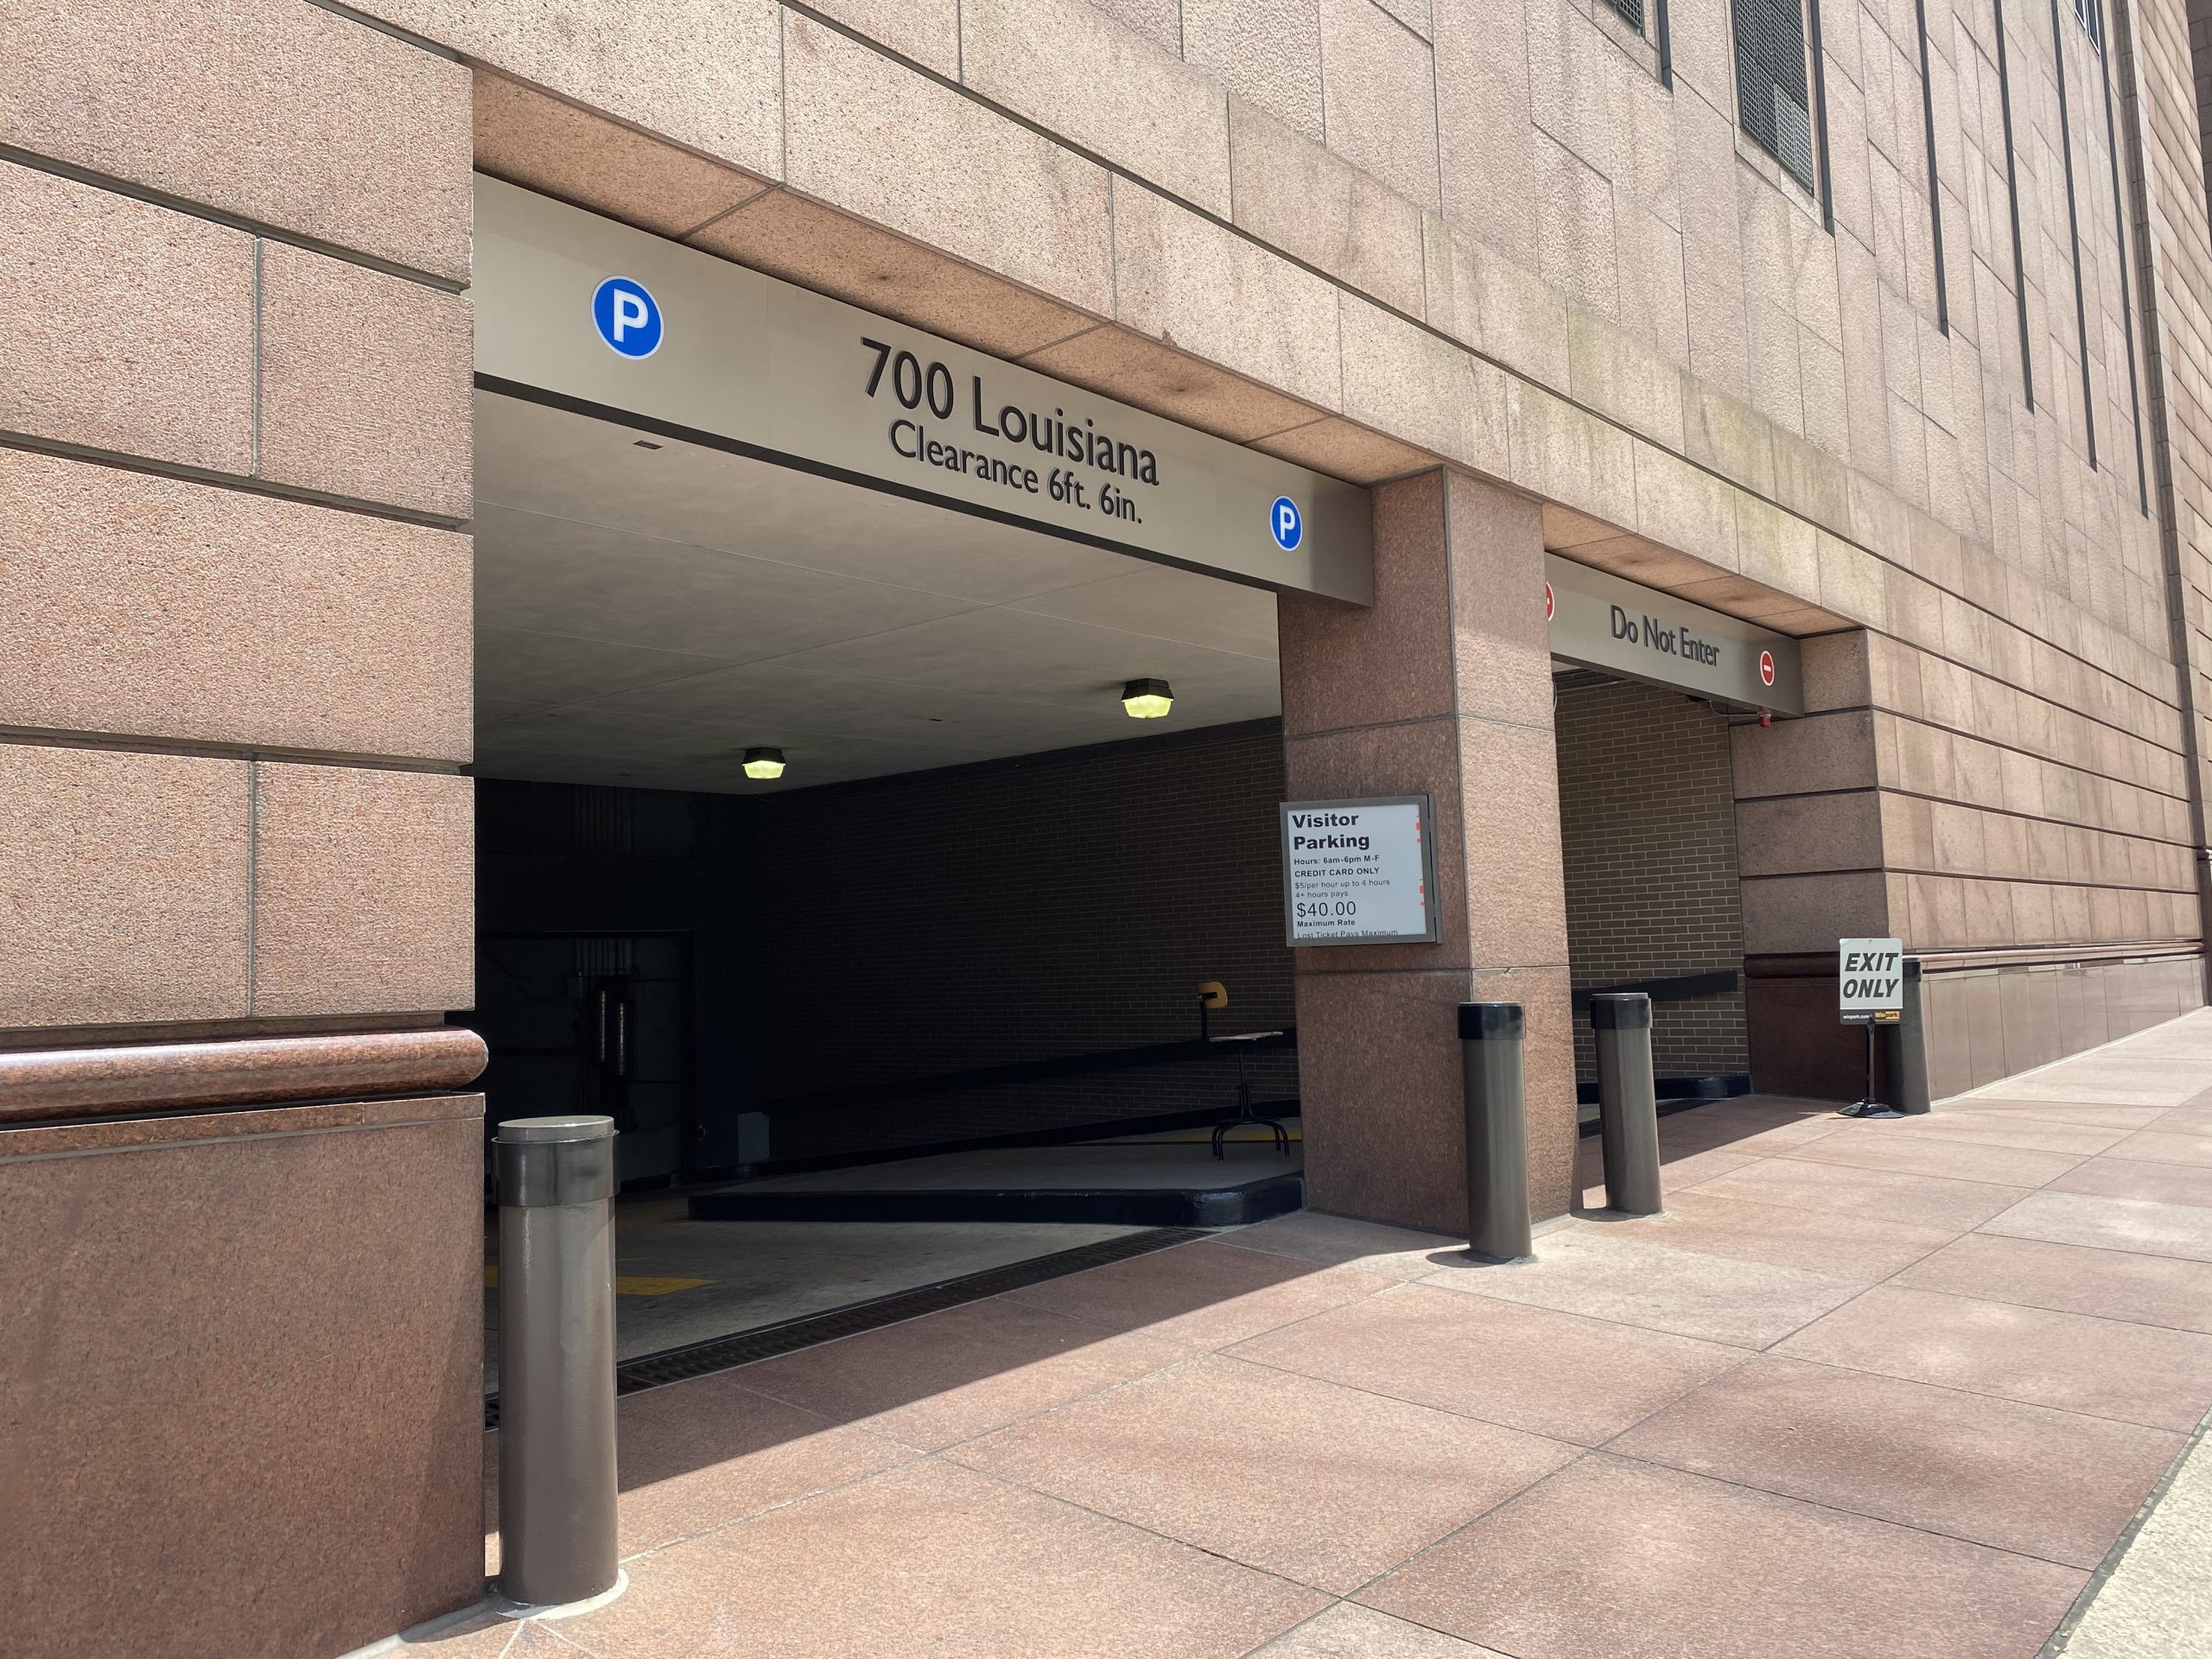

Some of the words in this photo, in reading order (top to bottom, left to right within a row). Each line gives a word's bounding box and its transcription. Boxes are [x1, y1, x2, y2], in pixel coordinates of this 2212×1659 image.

[613, 289, 649, 343] P
[861, 335, 955, 419] 700
[972, 375, 1160, 486] Louisiana
[888, 419, 1039, 494] Clearance
[1048, 467, 1091, 511] 6ft.
[1099, 482, 1143, 524] 6in.
[1280, 505, 1297, 541] P
[1611, 605, 1638, 644] Do
[1643, 614, 1676, 656] Not
[1679, 626, 1719, 667] Enter
[1292, 813, 1359, 829] Visitor
[1294, 835, 1370, 850] Parking
[1323, 855, 1362, 864] 6am-6pm
[1294, 869, 1326, 878] CREDIT
[1294, 881, 1319, 890] $5/per
[1297, 901, 1357, 918] $40.00
[1845, 952, 1899, 972] EXIT
[1843, 979, 1899, 998] ONLY
